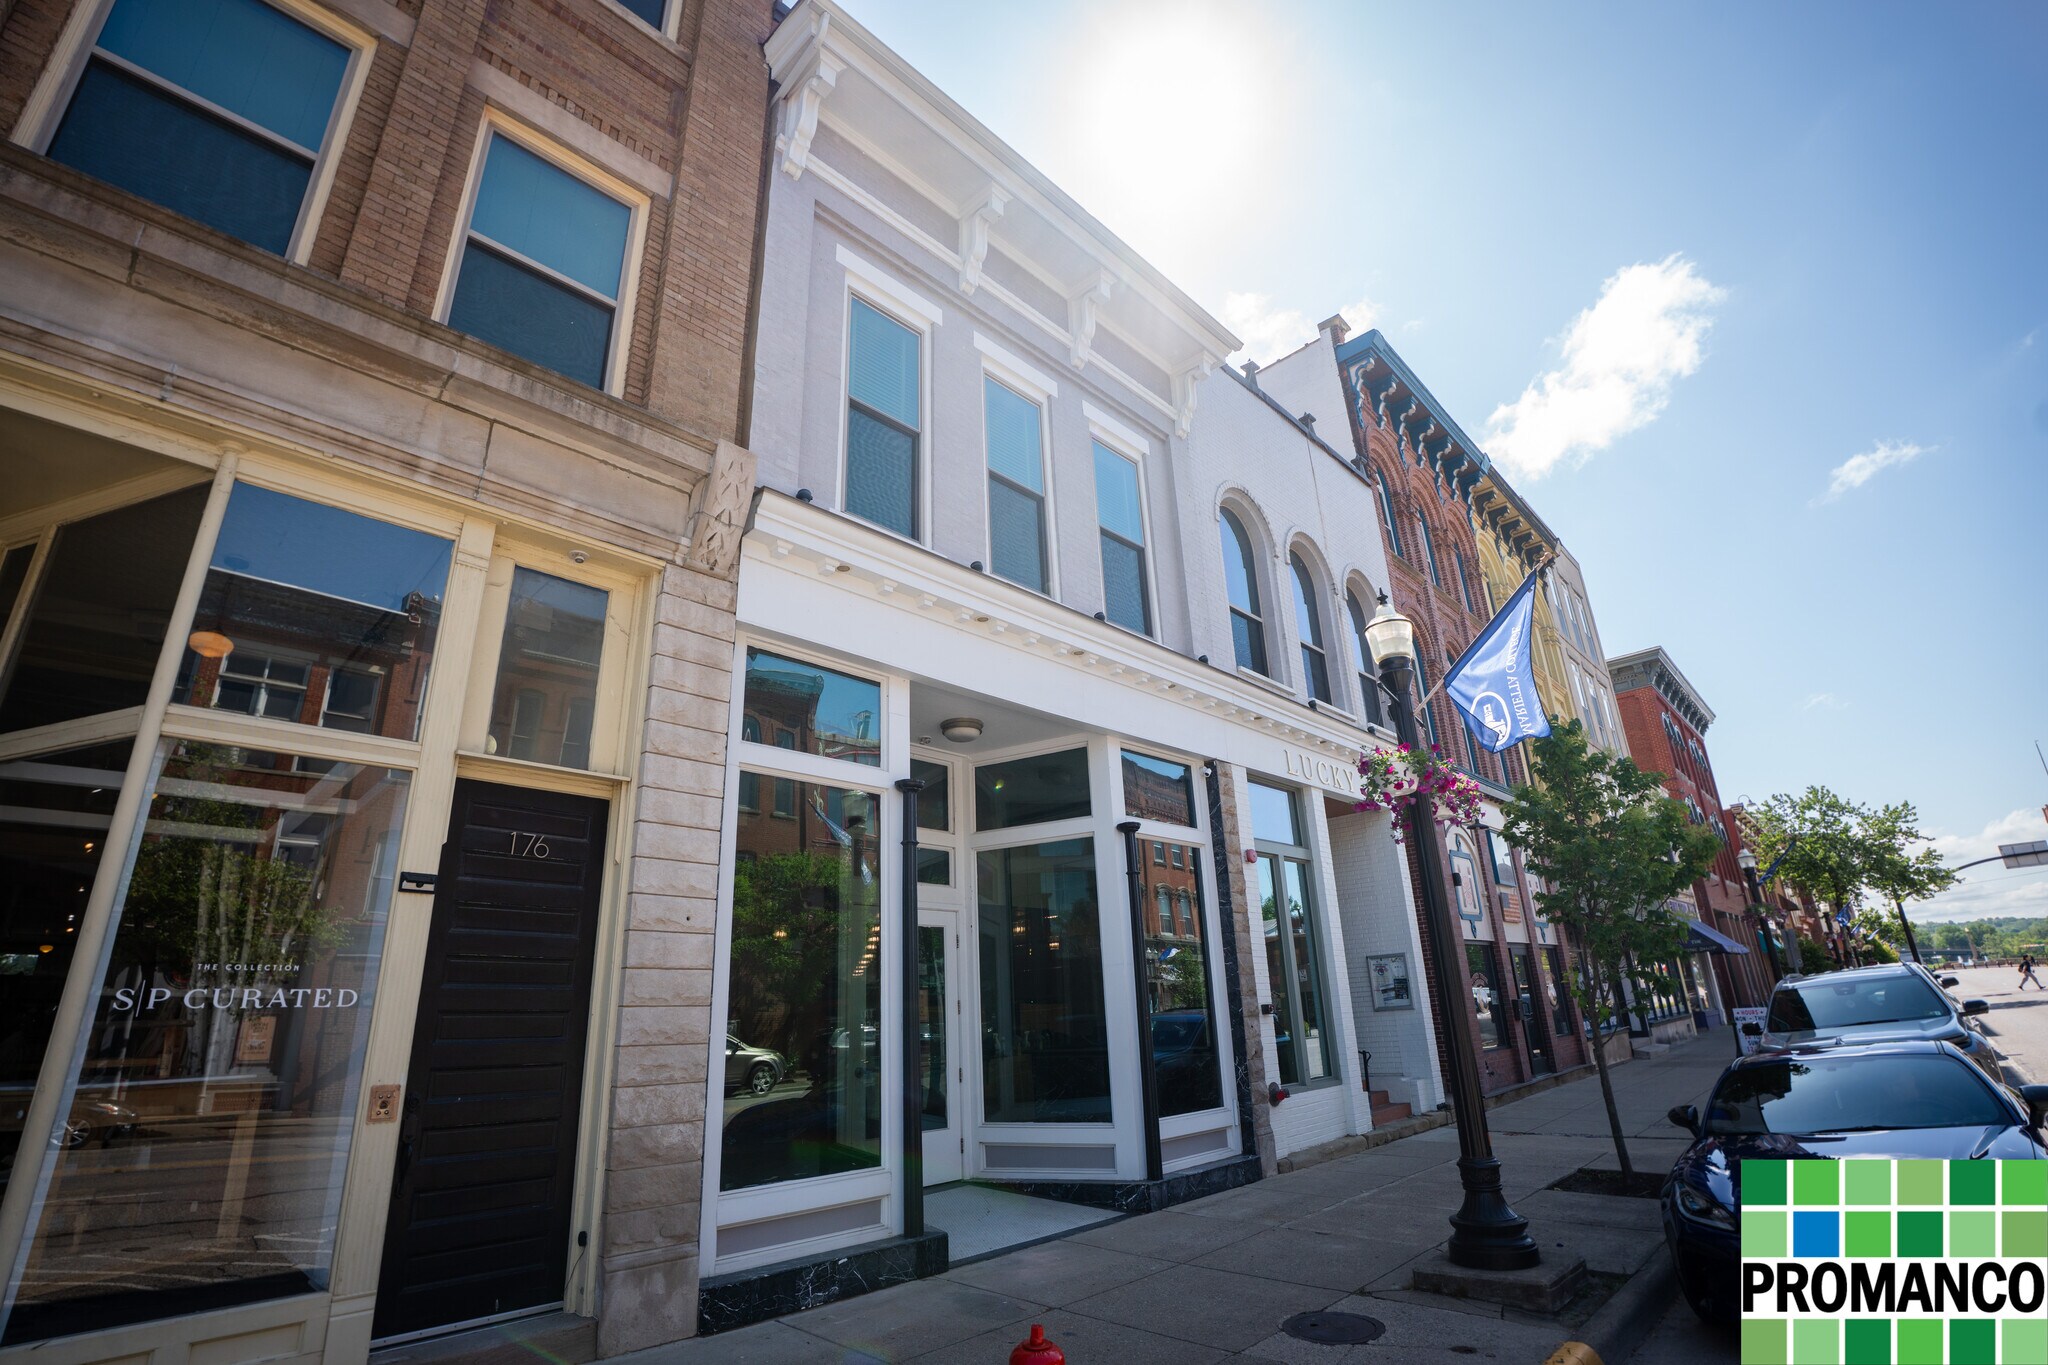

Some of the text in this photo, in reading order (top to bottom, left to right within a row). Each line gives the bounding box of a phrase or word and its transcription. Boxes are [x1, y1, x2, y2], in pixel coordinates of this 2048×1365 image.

[1284, 749, 1355, 794] LUCKY
[510, 831, 550, 858] 176
[197, 963, 301, 972] THE COLLECTION
[183, 988, 359, 1010] CURATED
